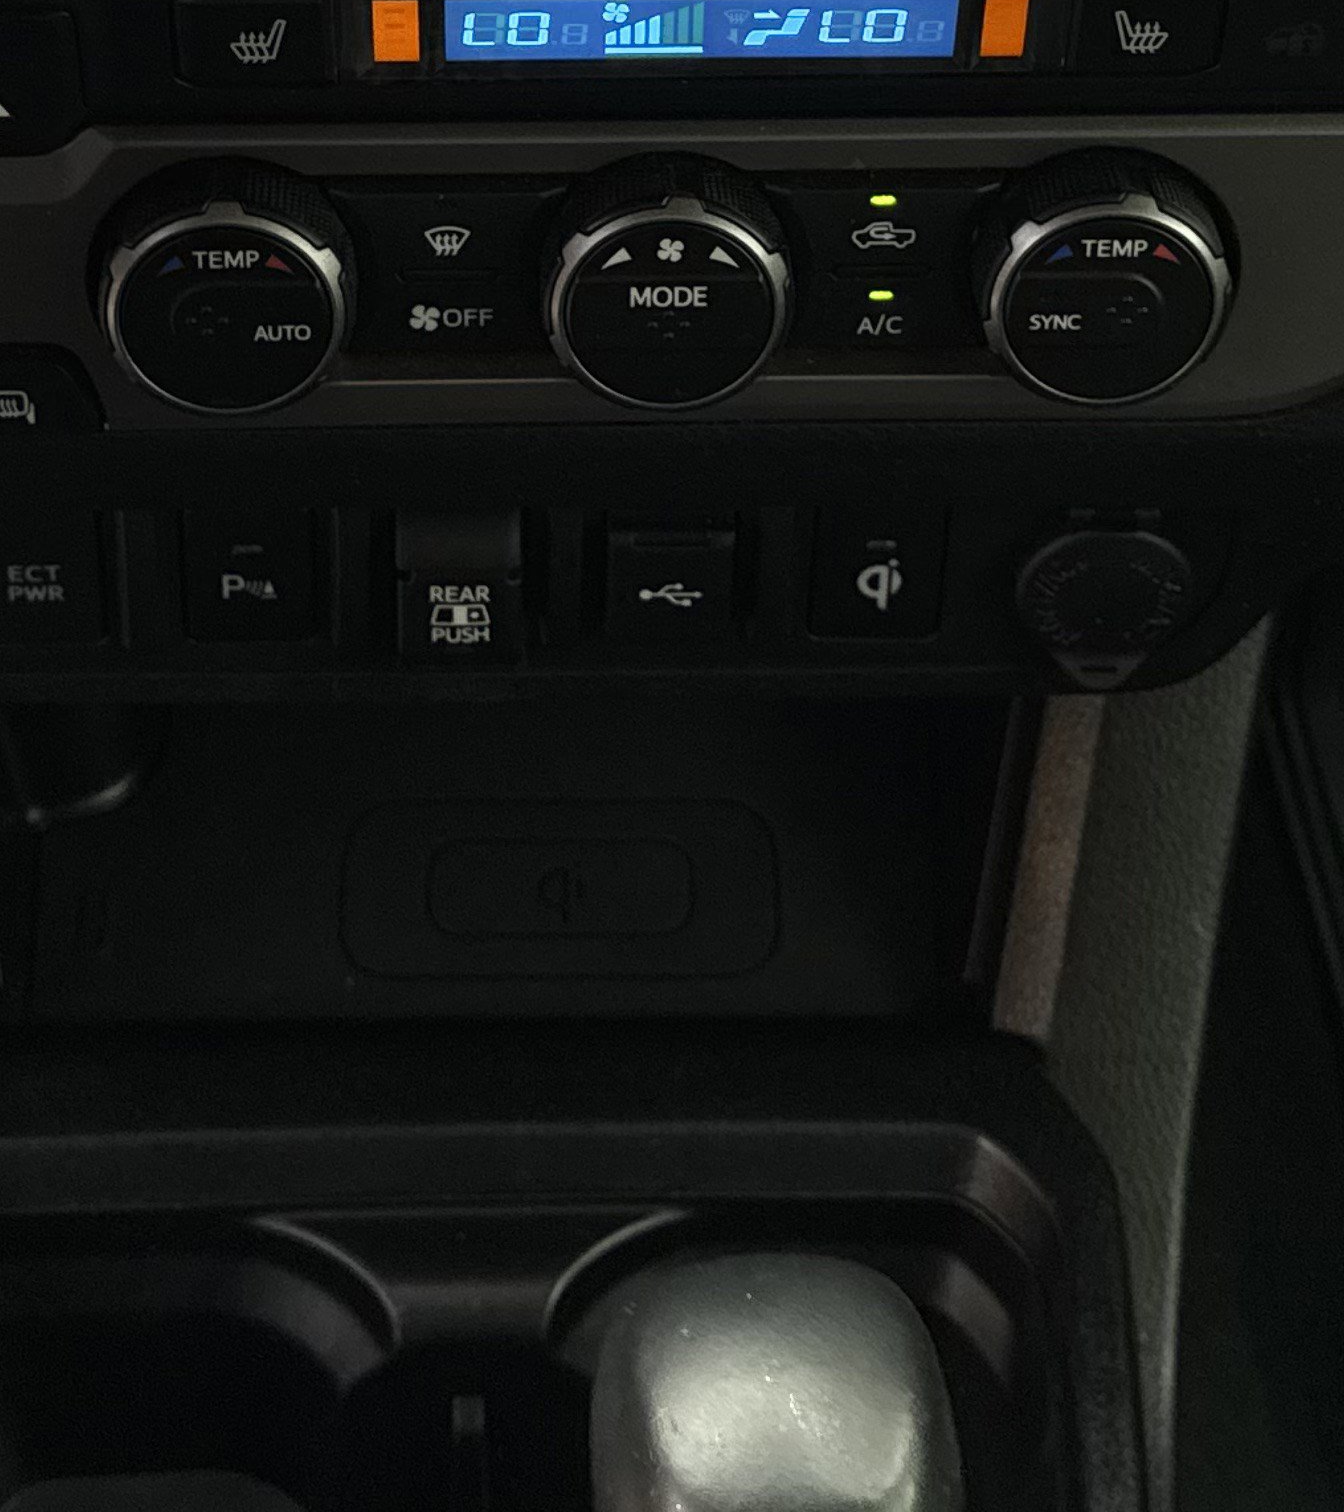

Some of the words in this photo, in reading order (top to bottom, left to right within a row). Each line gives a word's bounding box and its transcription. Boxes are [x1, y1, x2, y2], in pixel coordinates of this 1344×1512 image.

[1081, 239, 1148, 258] TEMP
[192, 250, 260, 269] TEMP
[629, 286, 708, 308] MODE
[441, 308, 493, 328] OFF
[856, 313, 903, 336] A/C
[1029, 314, 1082, 331] SYNC
[253, 324, 312, 342] AUTO
[7, 564, 60, 583] ECT
[8, 585, 63, 601] PWR
[430, 585, 490, 603] REAR
[431, 623, 490, 643] PUSH
